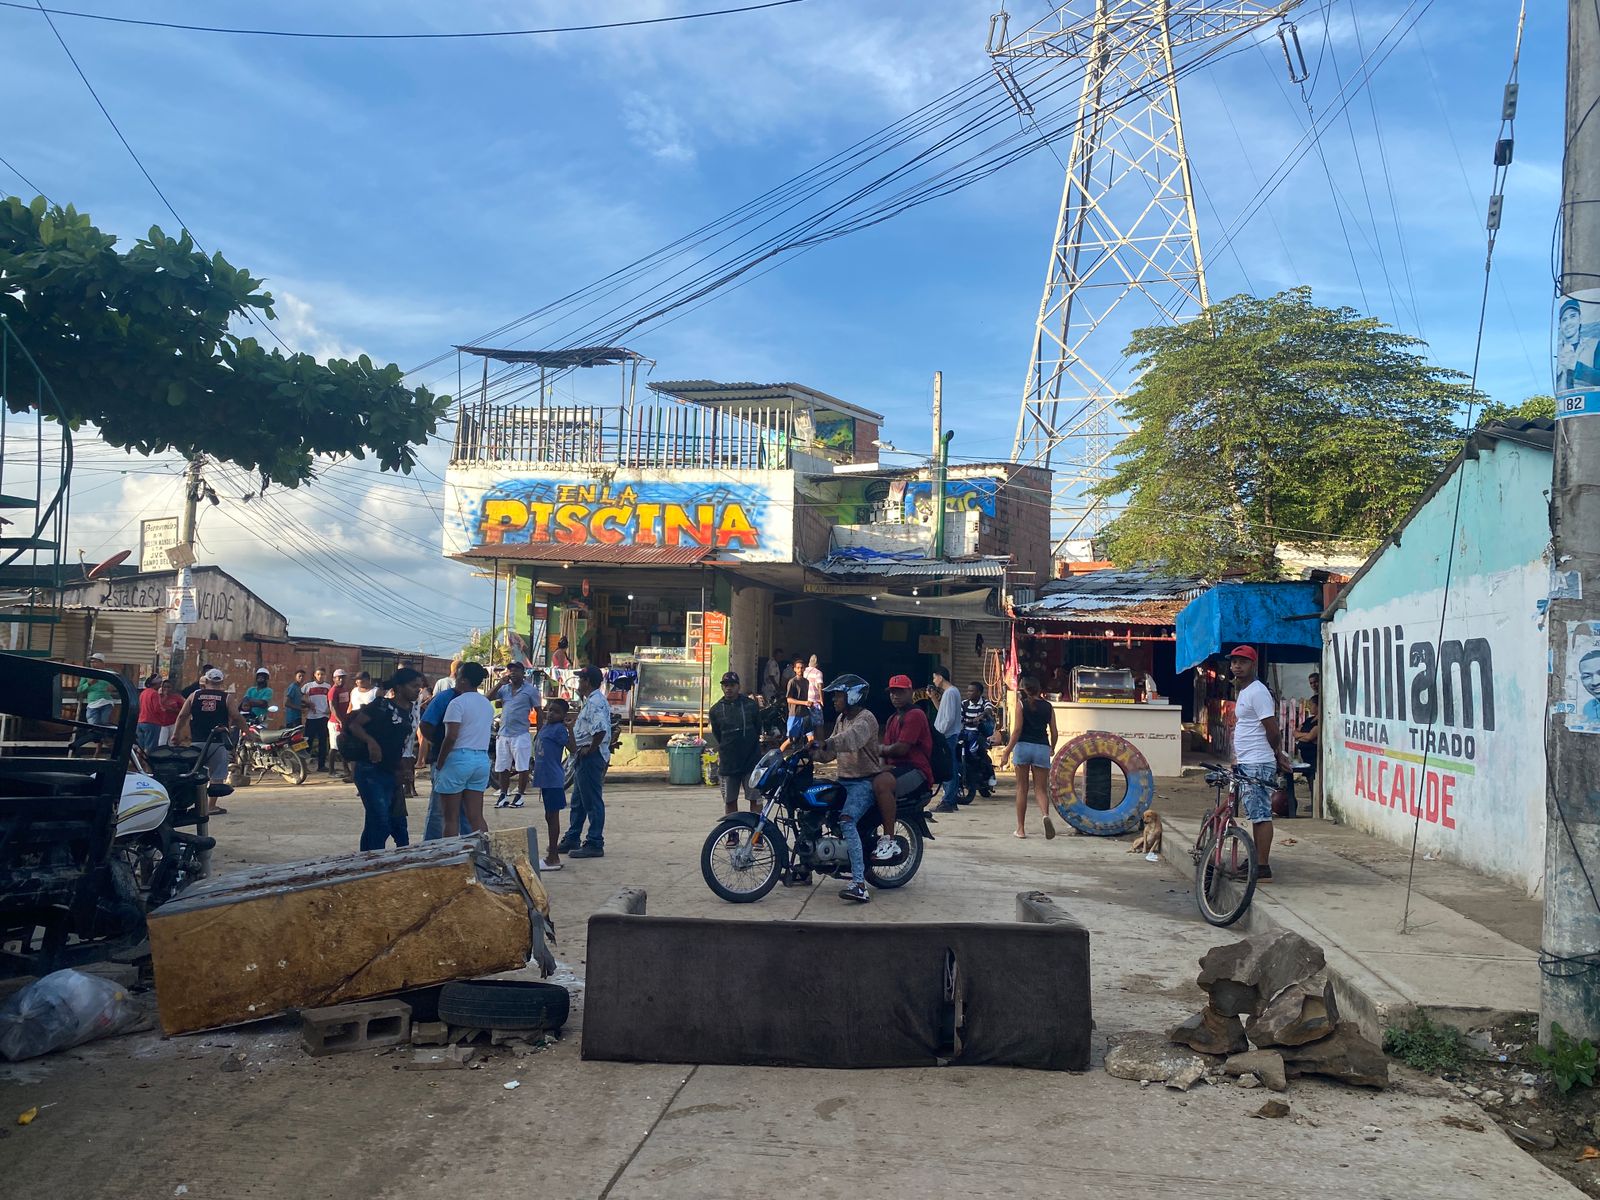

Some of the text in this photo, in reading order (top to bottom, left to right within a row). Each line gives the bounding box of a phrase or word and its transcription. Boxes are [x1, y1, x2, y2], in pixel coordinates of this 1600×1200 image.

[1566, 397, 1582, 411] 82
[558, 484, 638, 506] EN LA
[480, 499, 760, 548] PISCINA
[197, 592, 235, 622] VENDE
[1332, 625, 1495, 731] William
[202, 700, 216, 711] 23
[1344, 718, 1389, 745] GARCIA
[1409, 728, 1475, 760] TIRADO
[1355, 755, 1456, 830] ALCALDE
